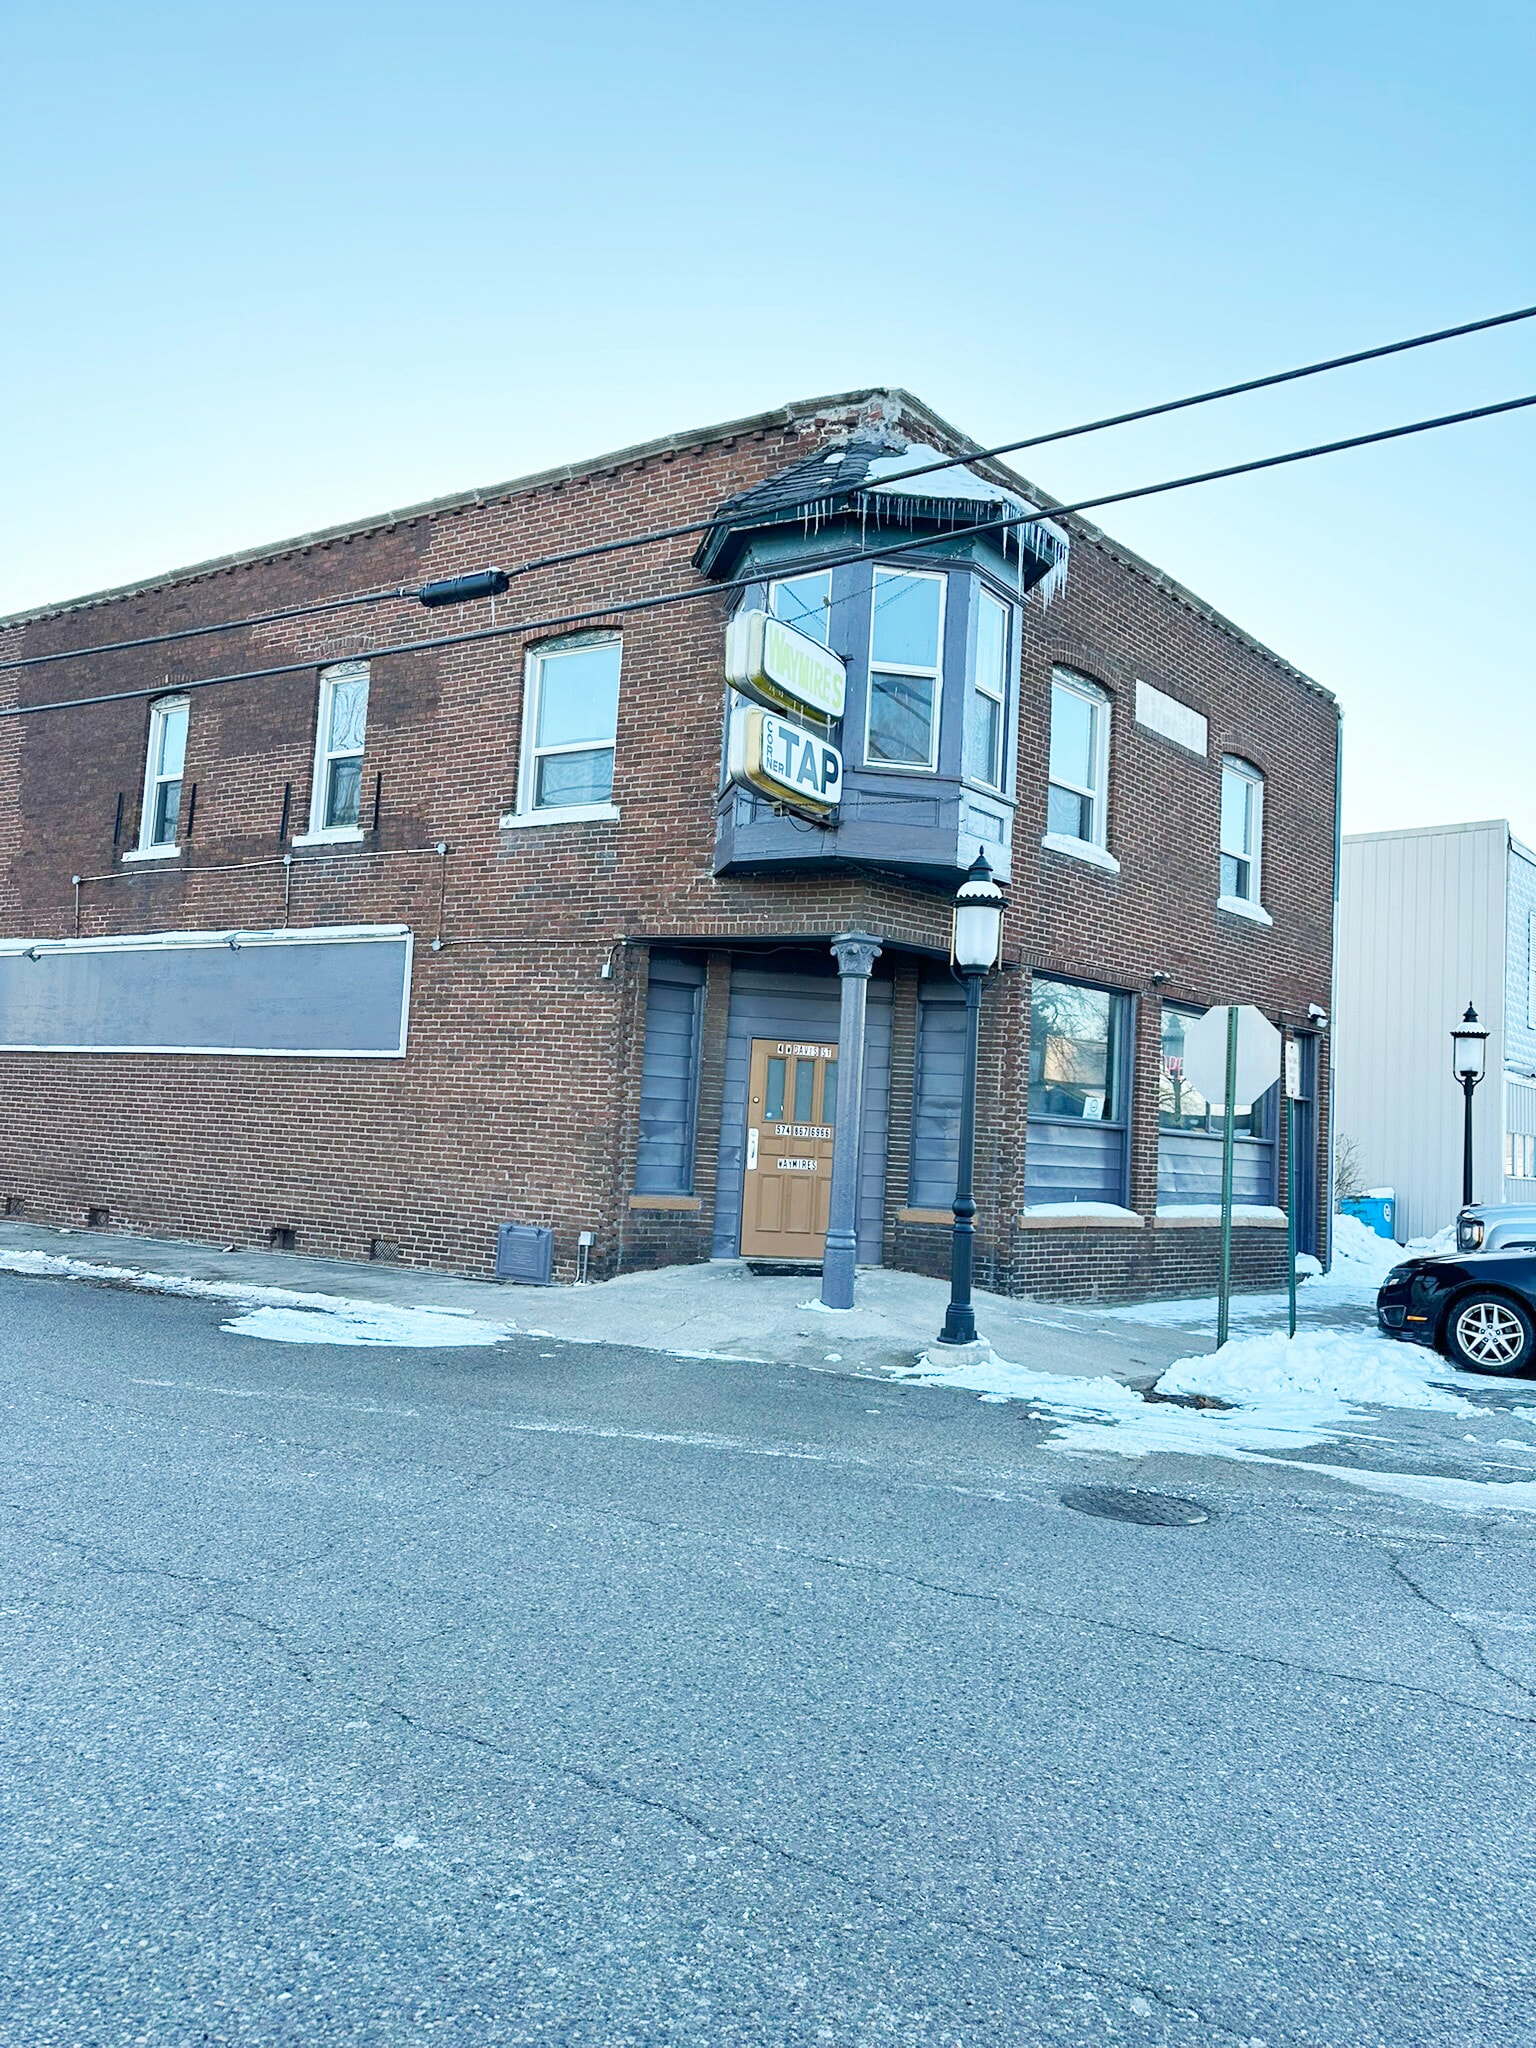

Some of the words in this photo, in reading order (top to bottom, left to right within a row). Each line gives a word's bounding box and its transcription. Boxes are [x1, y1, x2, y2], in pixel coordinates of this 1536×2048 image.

[766, 721, 785, 775] CORNER
[778, 725, 839, 795] TAP
[793, 1045, 818, 1056] DAVIS
[821, 1048, 831, 1057] ST
[776, 1125, 790, 1135] 574
[778, 1159, 817, 1170] WAYMIRES
